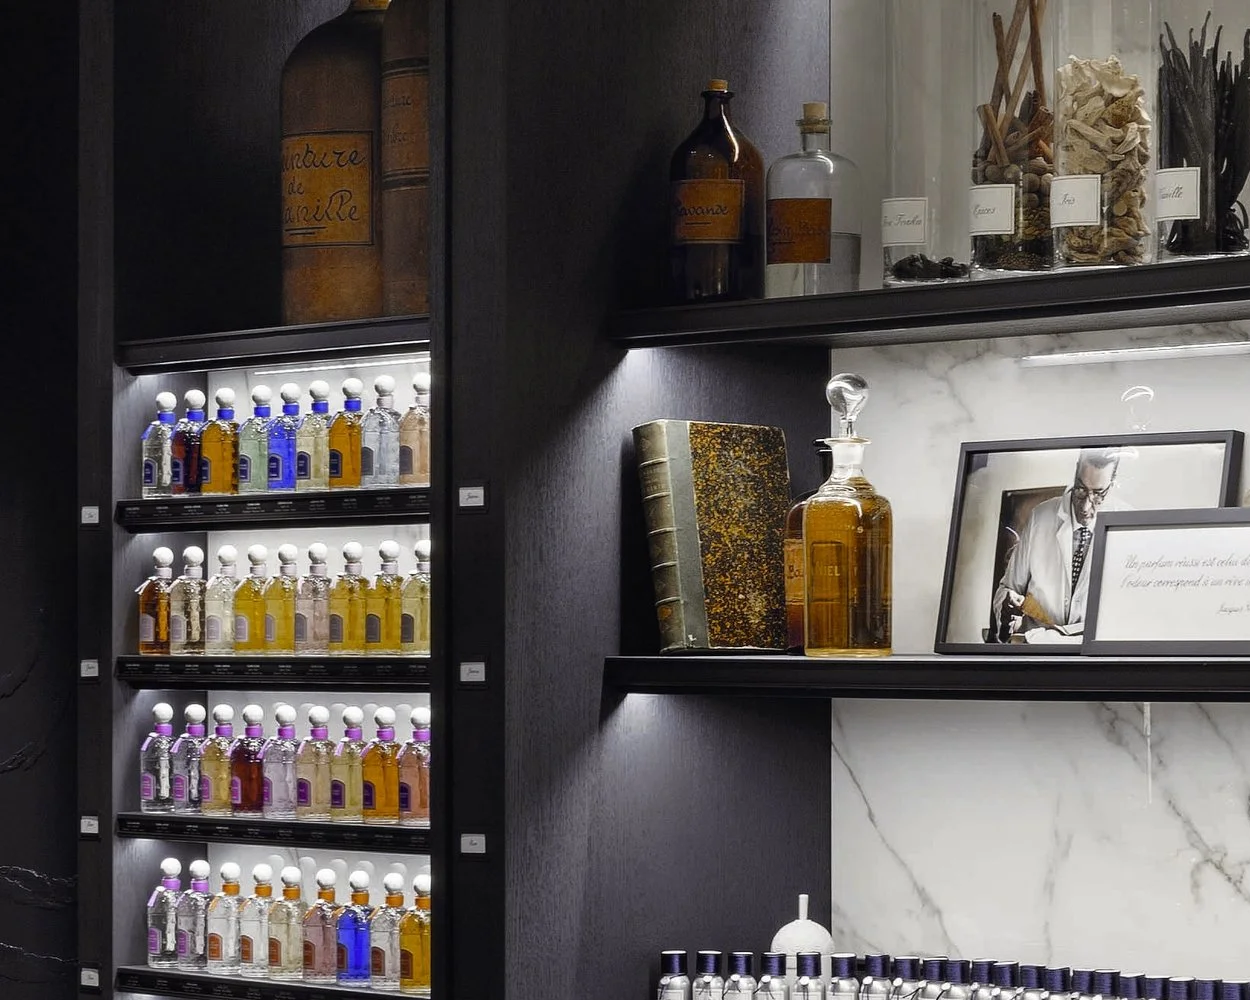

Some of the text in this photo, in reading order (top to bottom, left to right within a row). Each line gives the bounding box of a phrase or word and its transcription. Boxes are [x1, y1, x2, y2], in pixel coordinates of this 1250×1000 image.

[288, 176, 305, 195] de
[283, 189, 361, 223] anille
[676, 202, 729, 217] avande
